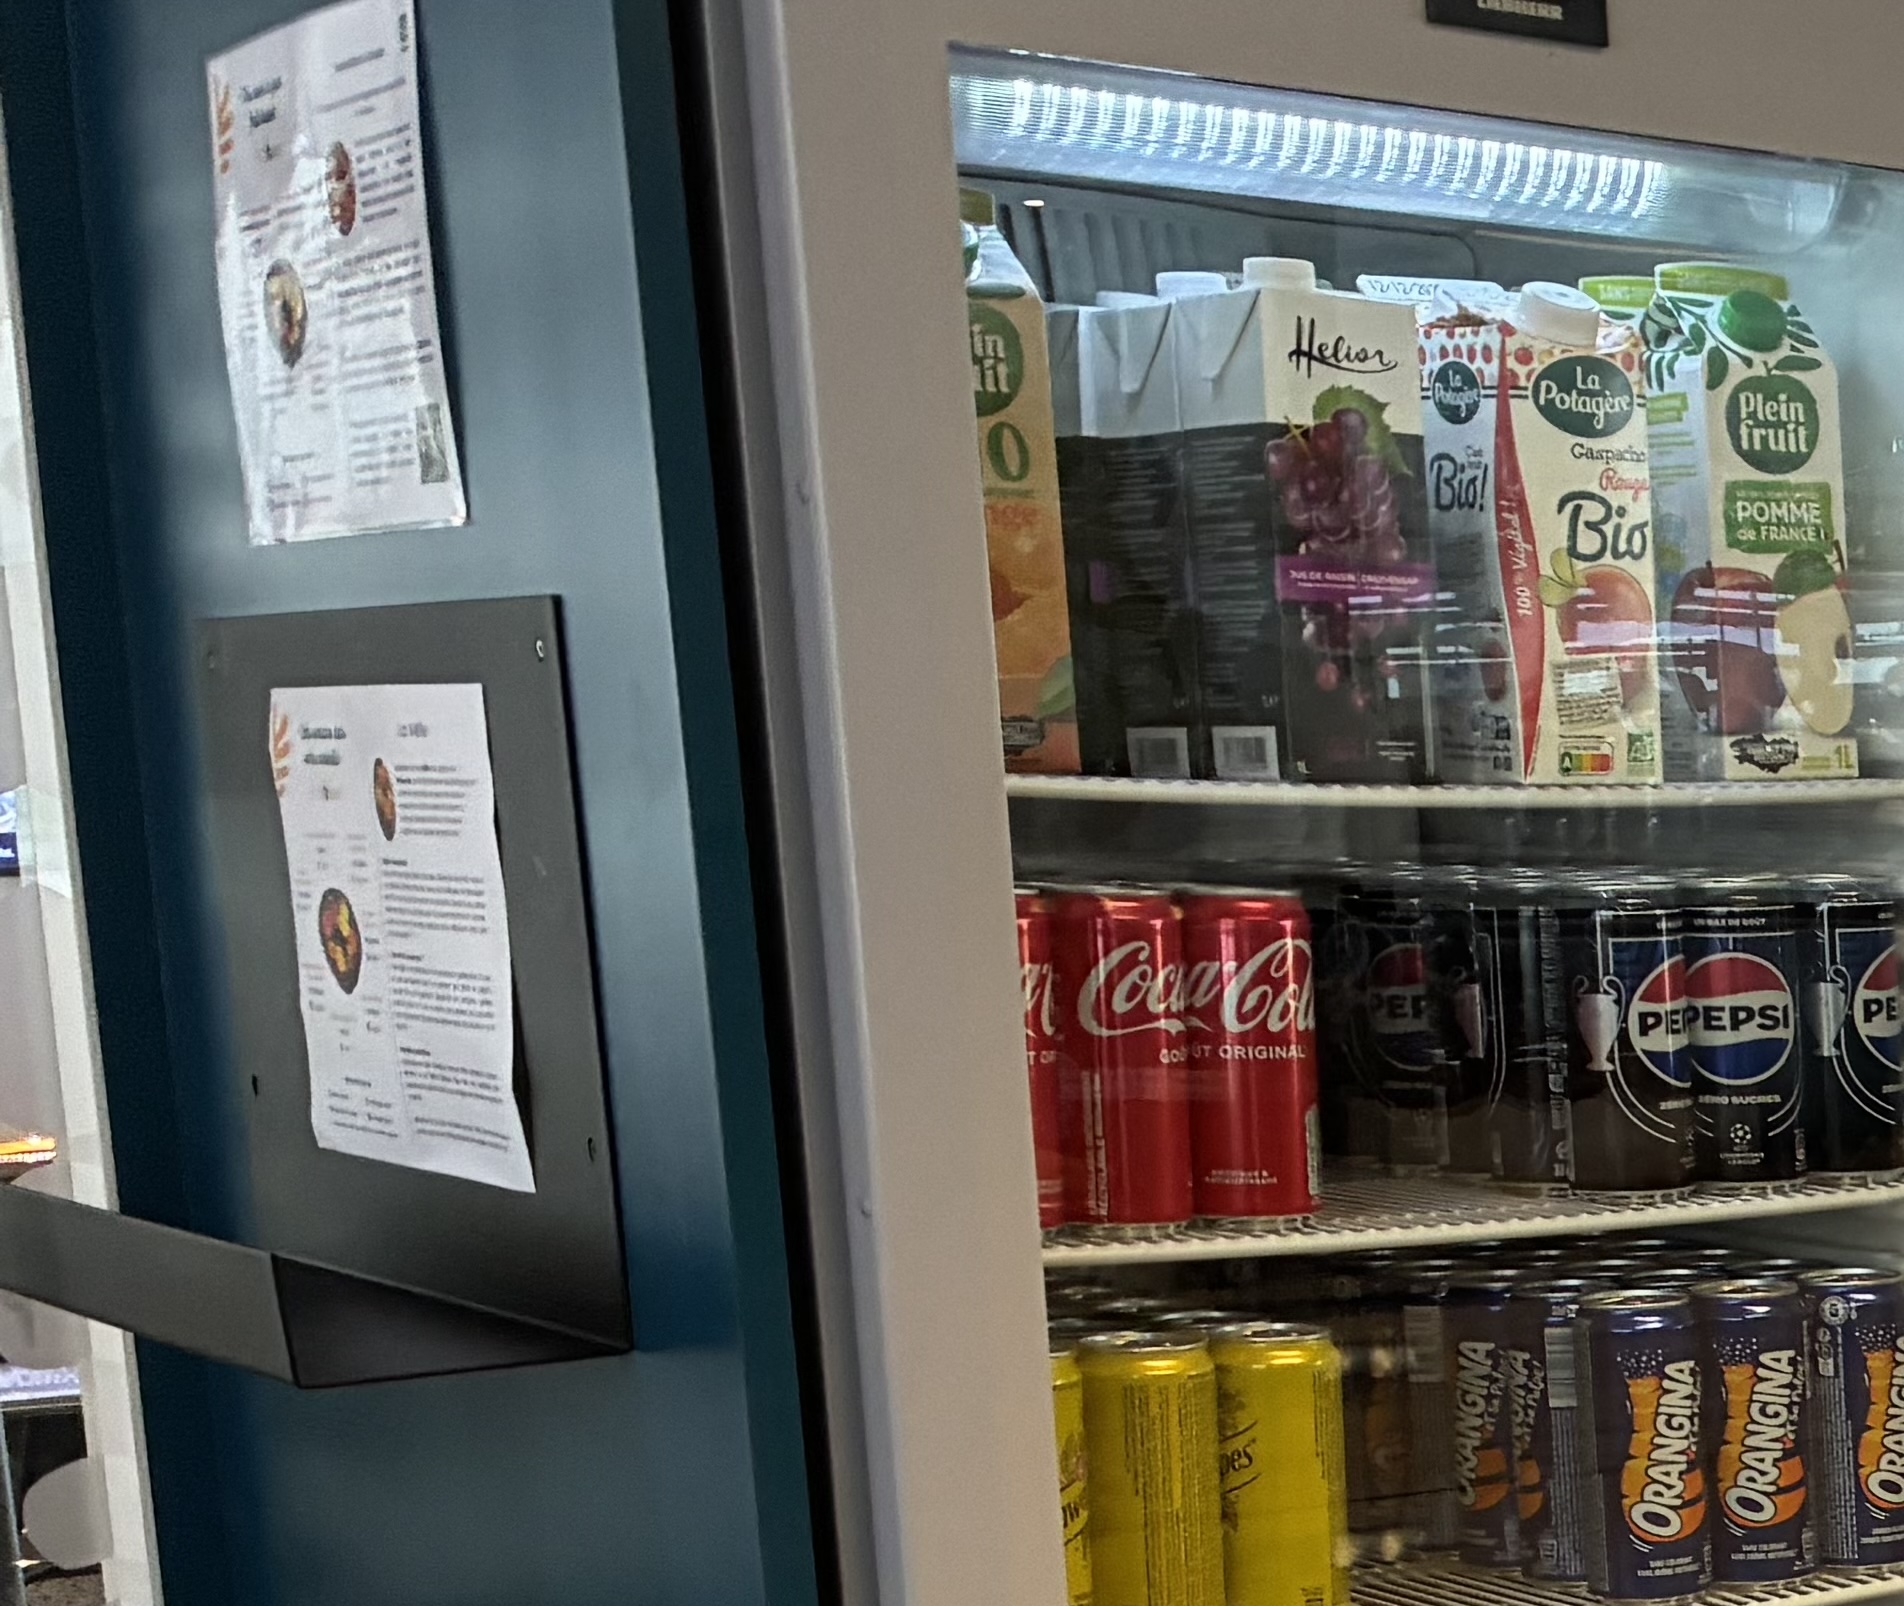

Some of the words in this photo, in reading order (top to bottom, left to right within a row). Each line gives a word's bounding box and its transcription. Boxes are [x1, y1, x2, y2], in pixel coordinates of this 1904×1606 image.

[1288, 314, 1398, 378] Helior
[1576, 366, 1601, 390] La
[1538, 379, 1630, 430] Potagère
[1738, 391, 1805, 423] Plein
[1740, 419, 1809, 453] fruit
[1430, 452, 1488, 512] Bio!
[1557, 490, 1649, 562] Bio
[1736, 500, 1822, 525] POMME
[1737, 529, 1757, 541] de
[1760, 525, 1817, 542] FRANCE
[1219, 1045, 1305, 1060] ORIGINAL
[1631, 1359, 1695, 1538] ORANGINA
[1725, 1349, 1796, 1523] ORANGINA
